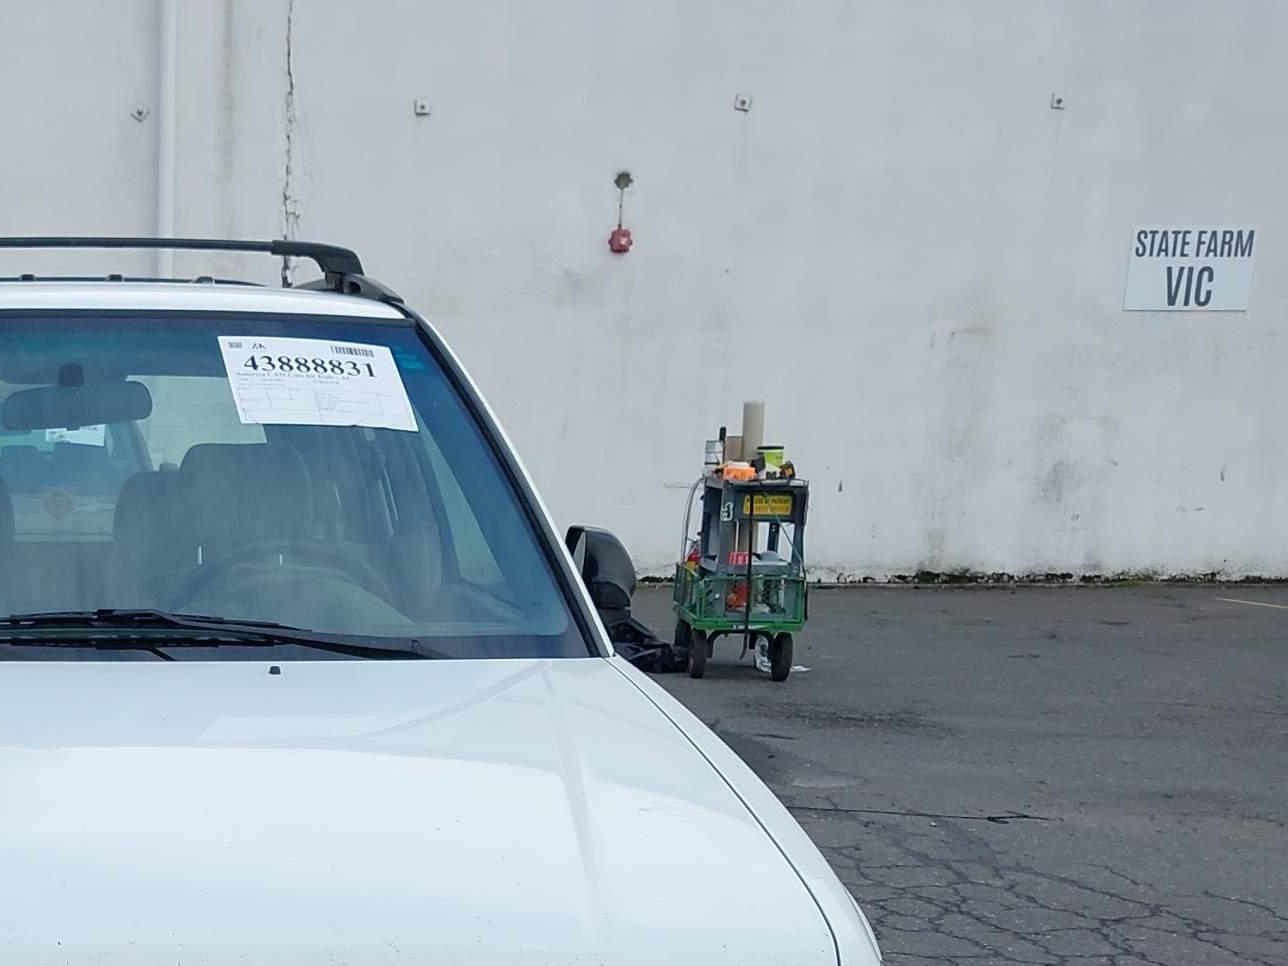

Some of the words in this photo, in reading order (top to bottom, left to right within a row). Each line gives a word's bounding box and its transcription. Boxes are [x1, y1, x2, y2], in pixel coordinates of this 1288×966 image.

[1135, 230, 1192, 257] STATE
[1195, 230, 1255, 257] FARM
[1166, 266, 1214, 307] VIC
[243, 354, 376, 378] 43888831
